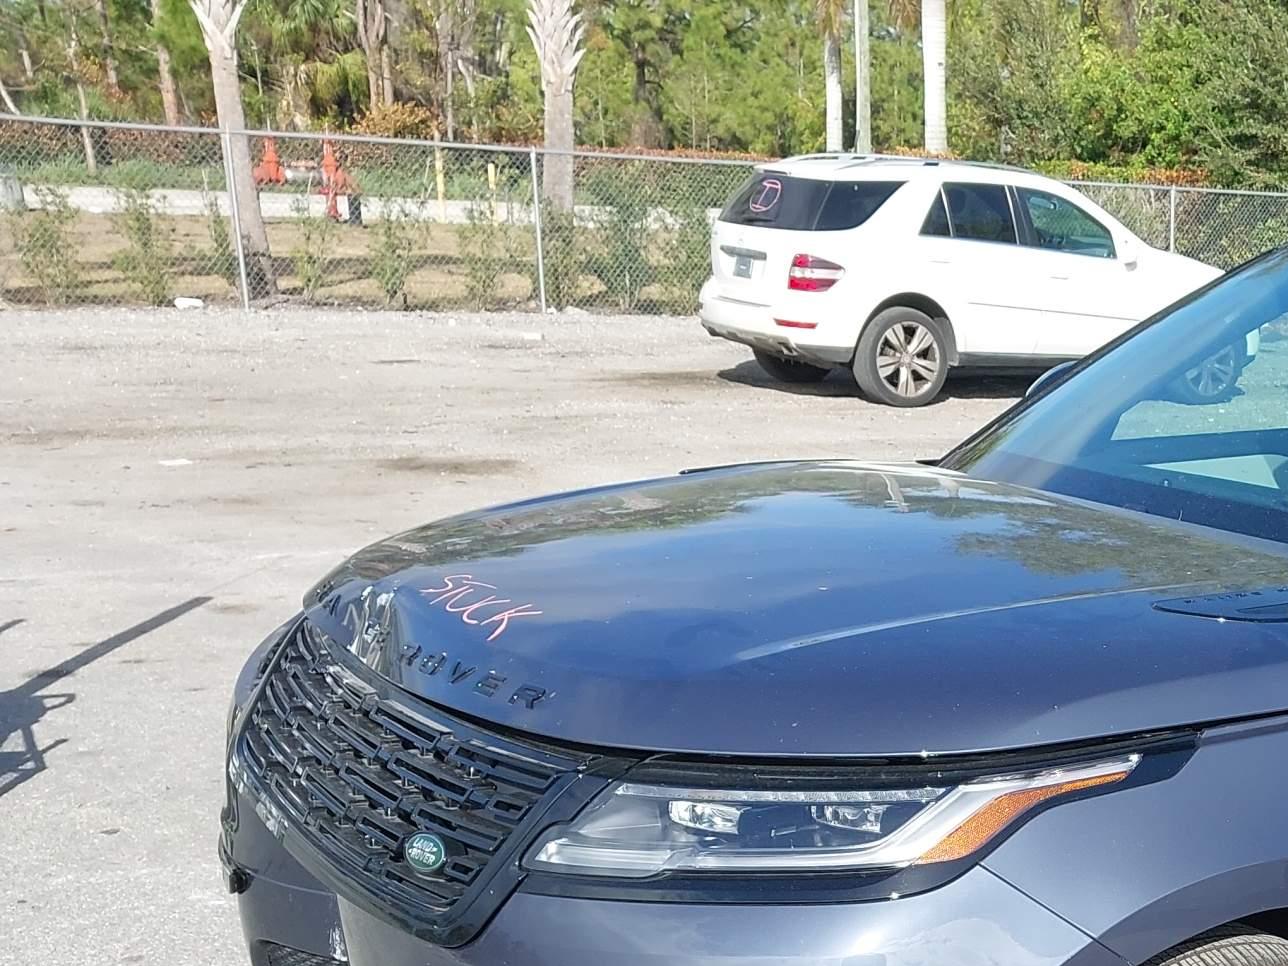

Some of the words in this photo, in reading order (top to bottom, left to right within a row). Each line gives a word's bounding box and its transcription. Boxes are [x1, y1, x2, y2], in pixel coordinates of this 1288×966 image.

[419, 574, 544, 642] STUCK
[412, 837, 434, 852] LAND
[410, 847, 436, 866] ROVER
